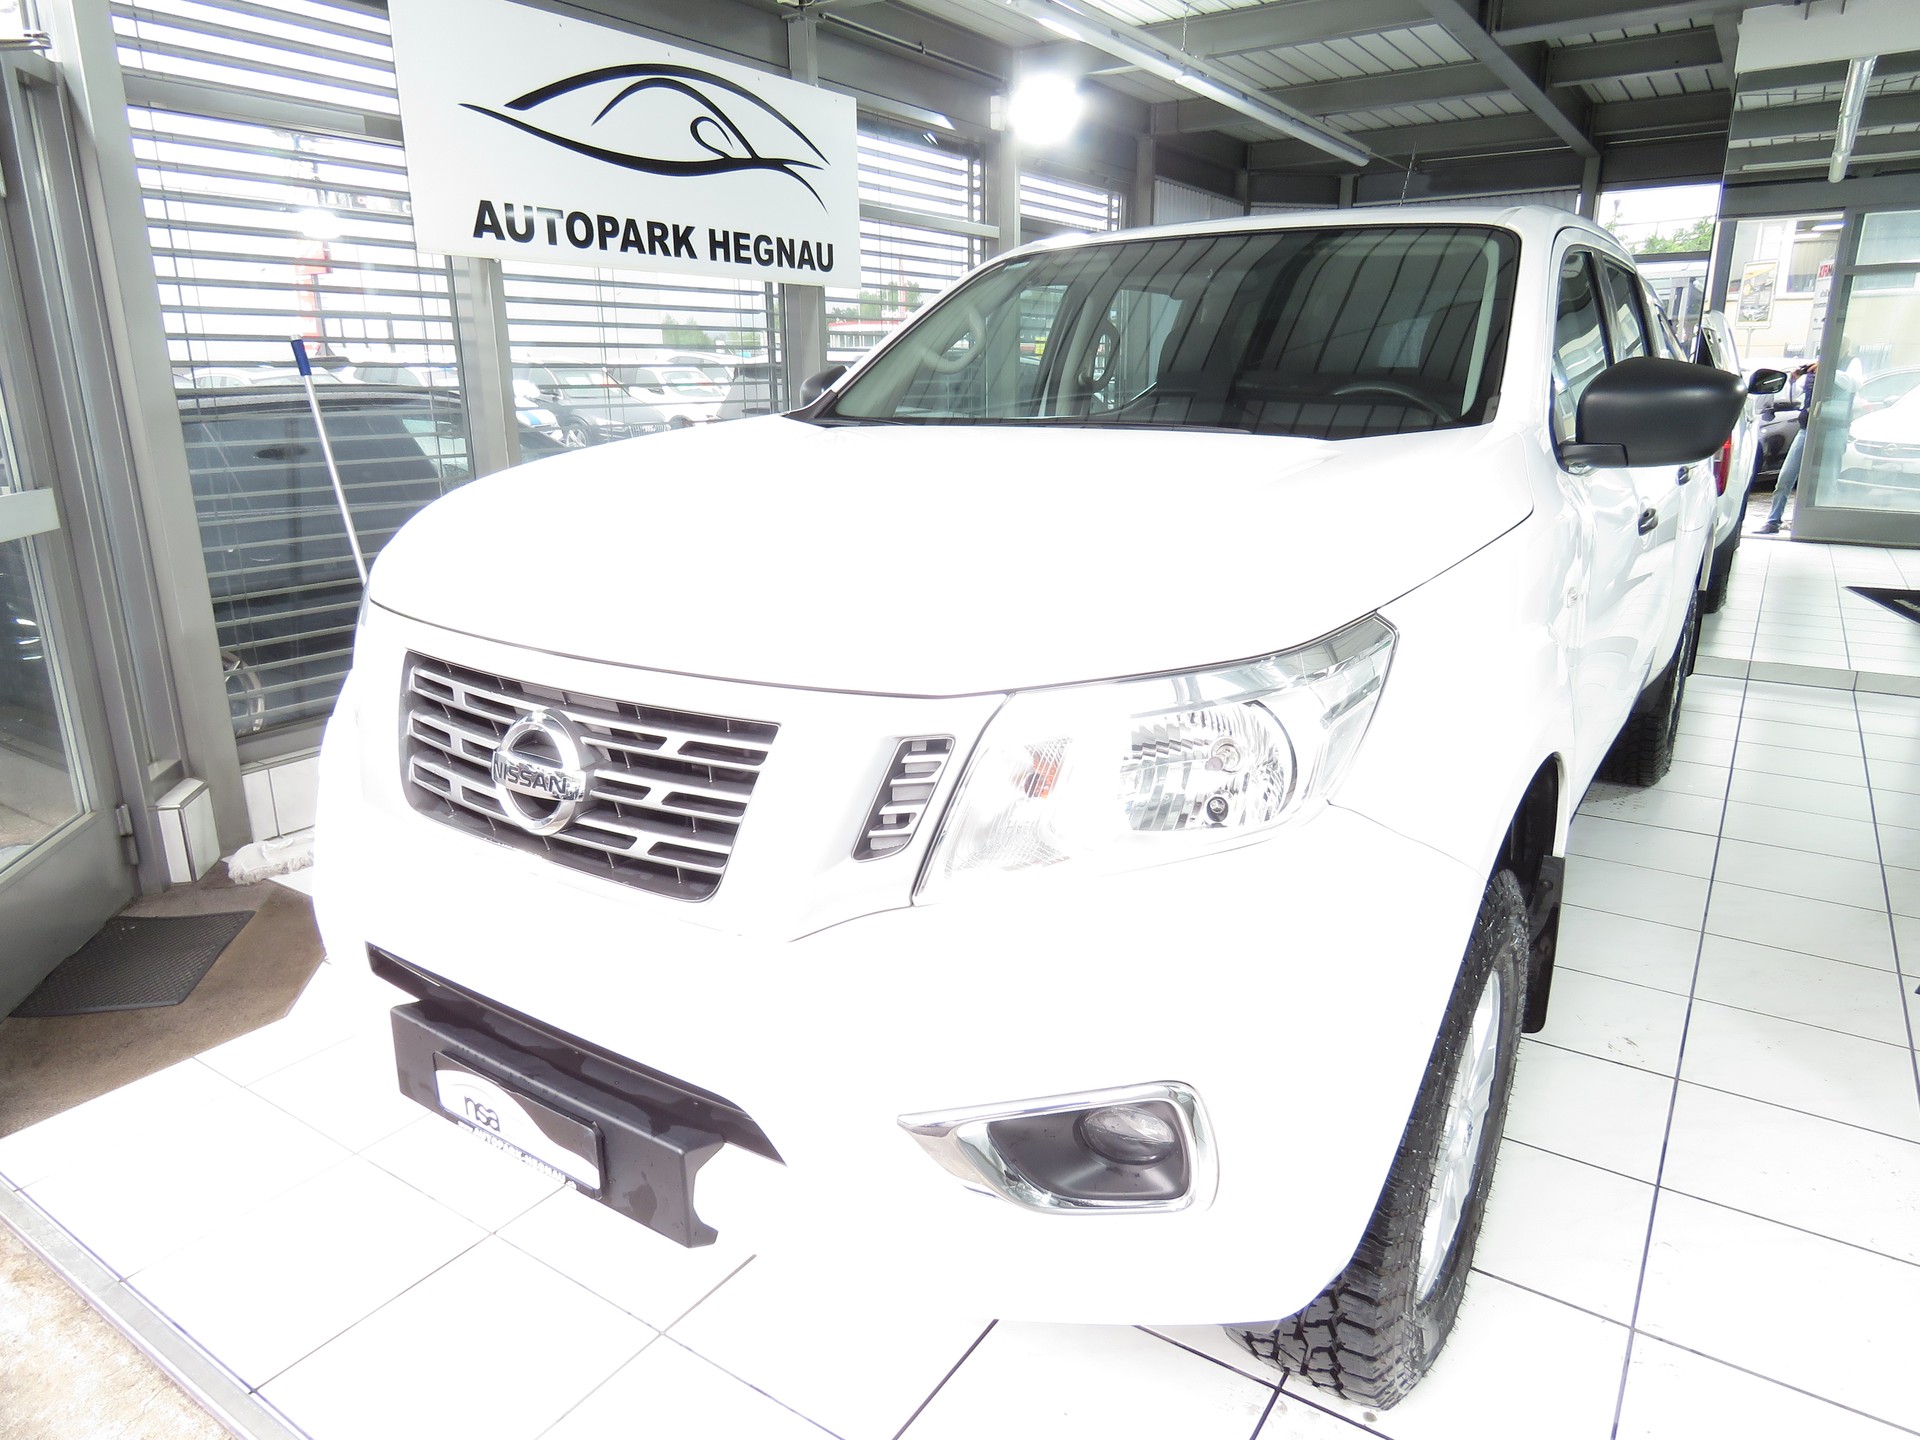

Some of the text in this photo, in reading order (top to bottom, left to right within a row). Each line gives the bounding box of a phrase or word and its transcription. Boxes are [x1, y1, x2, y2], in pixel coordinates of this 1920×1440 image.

[473, 199, 698, 259] AUTOPARK
[708, 228, 834, 273] HEGNAU
[492, 760, 567, 795] NISSAN
